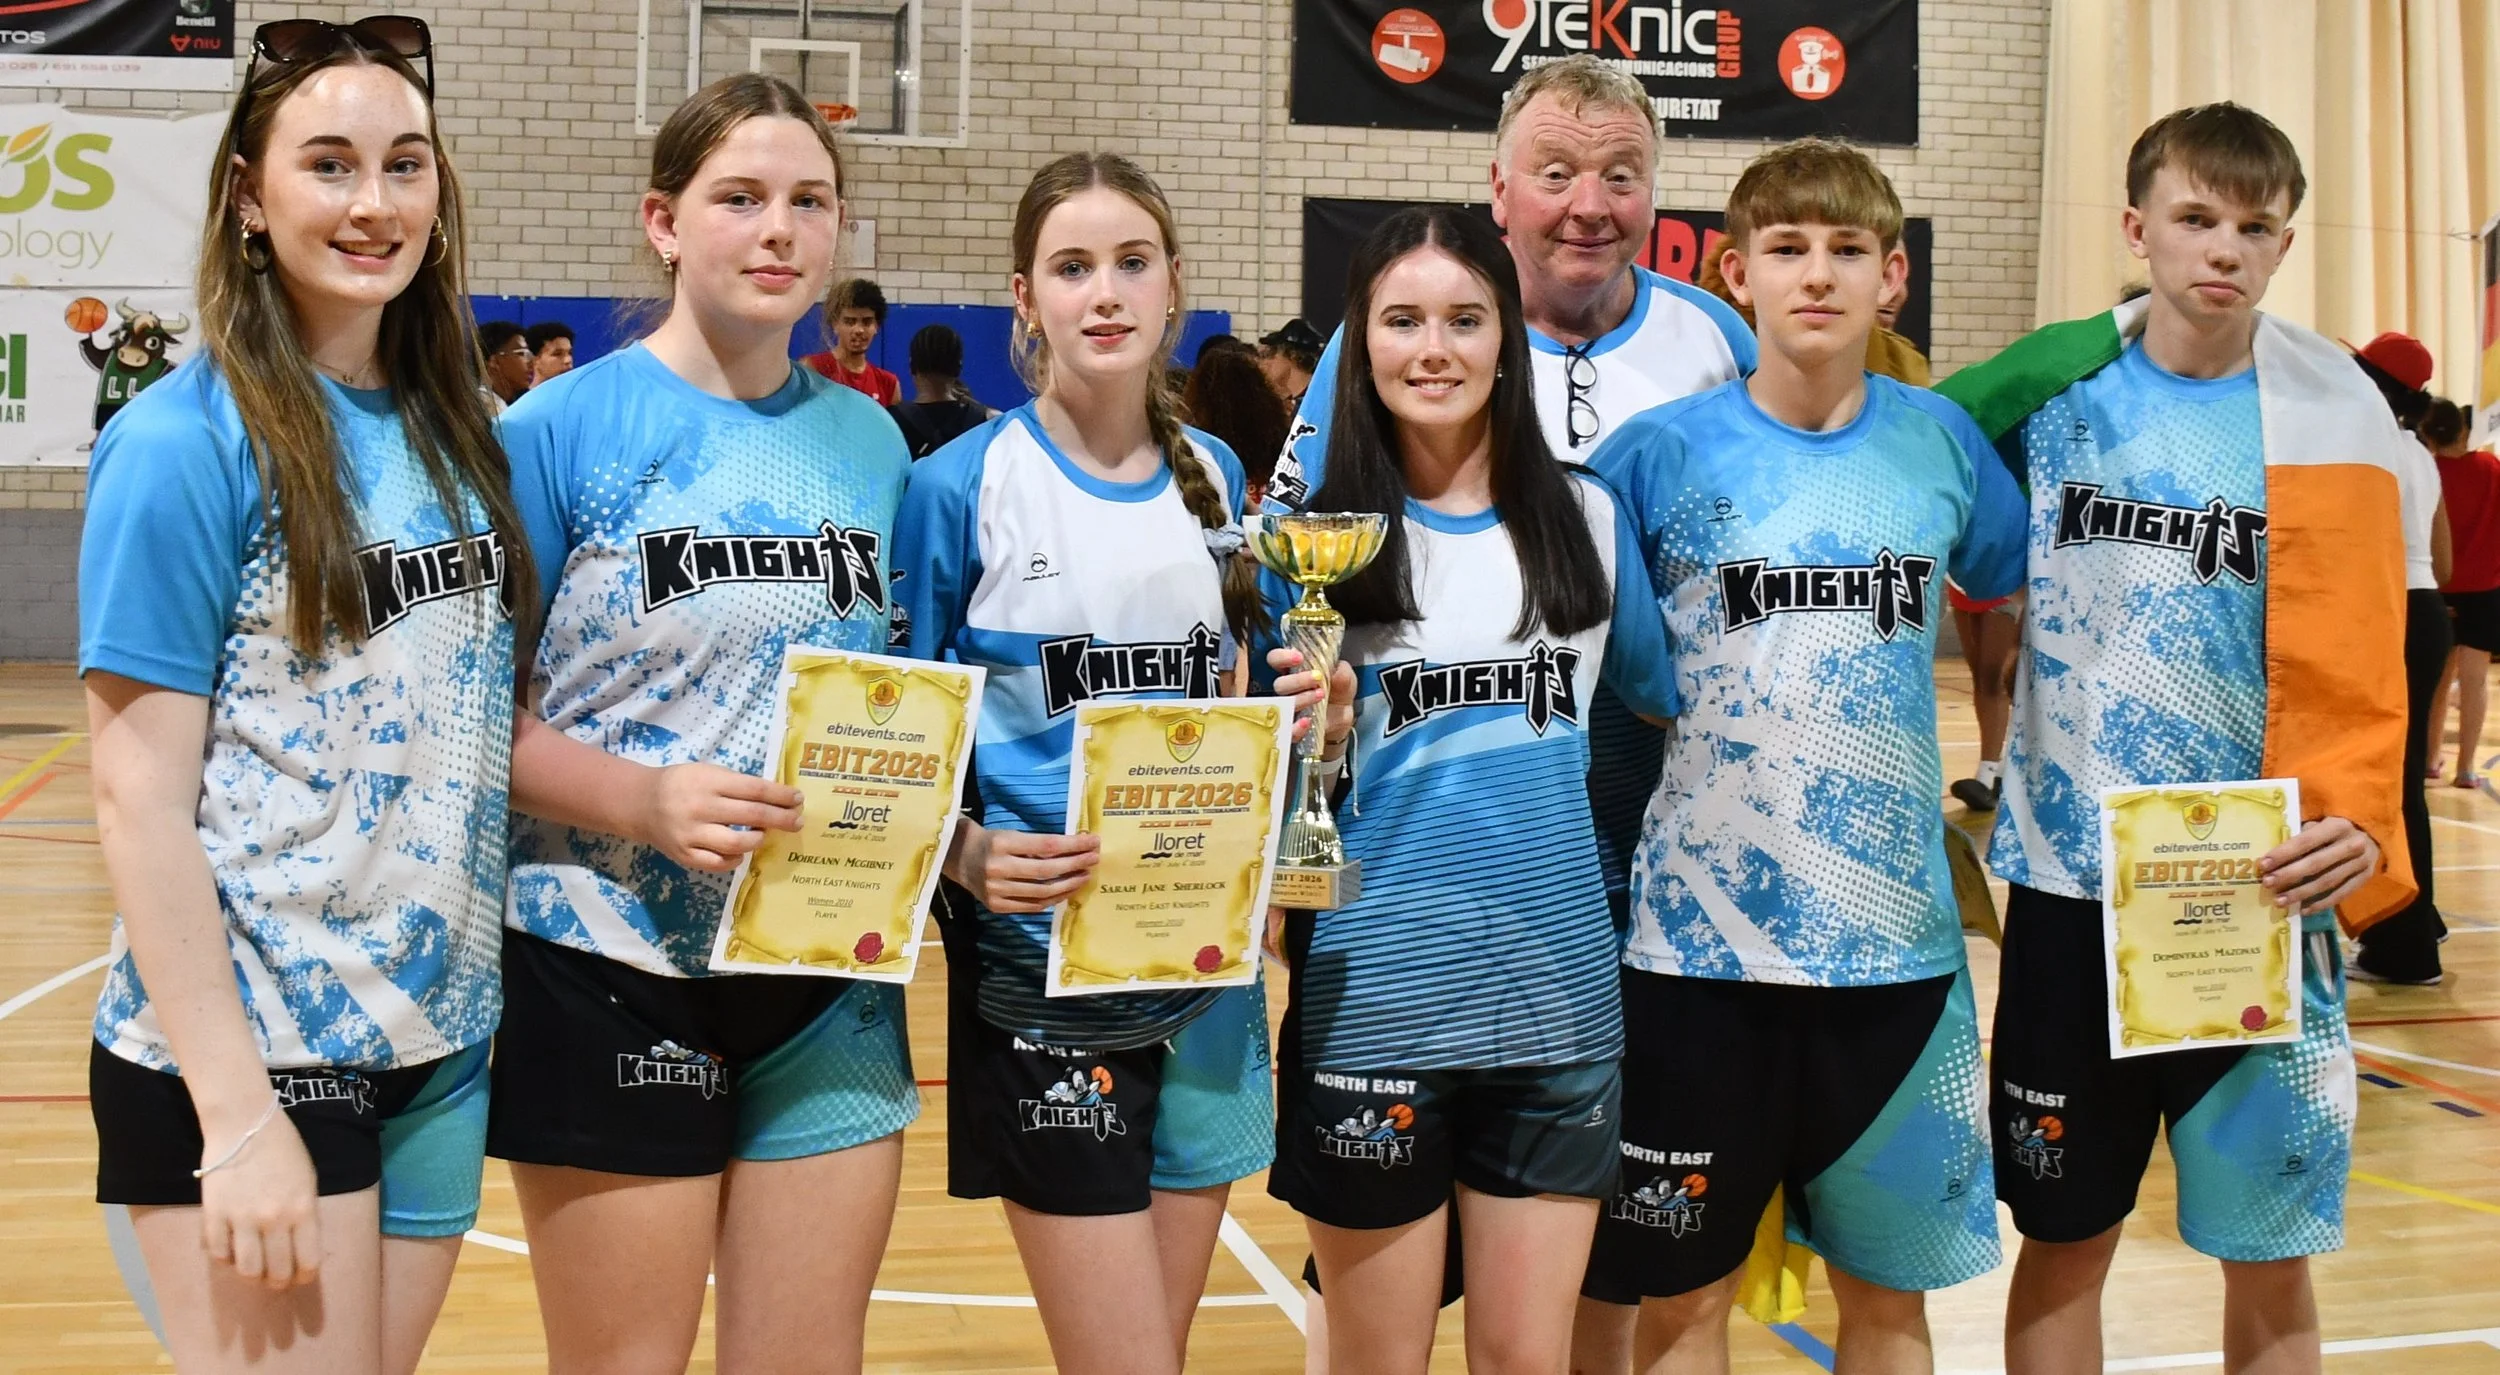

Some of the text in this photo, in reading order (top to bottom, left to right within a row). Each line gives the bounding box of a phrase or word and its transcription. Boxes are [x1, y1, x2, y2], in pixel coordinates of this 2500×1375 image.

[176, 16, 215, 26] Benelli
[1717, 10, 1741, 78] GRUP
[827, 723, 926, 743] ebitevents.com
[799, 742, 940, 780] EBIT2026
[1128, 764, 1234, 776] ebitevents.com
[1103, 782, 1253, 810] EBIT2026
[842, 800, 892, 823] lloret
[1154, 832, 1205, 851] lloret
[2153, 841, 2250, 854] ebitevents.com
[787, 852, 840, 866] DOIREANN
[792, 874, 881, 890] NORTH EAST KNIGHTS
[1100, 881, 1226, 895] SARAH JANE SHERLOCK
[2184, 901, 2231, 918] lloret
[1314, 1071, 1417, 1095] NORTH EAST
[2026, 1089, 2066, 1108] EAST
[1670, 1151, 1714, 1165] EAST
